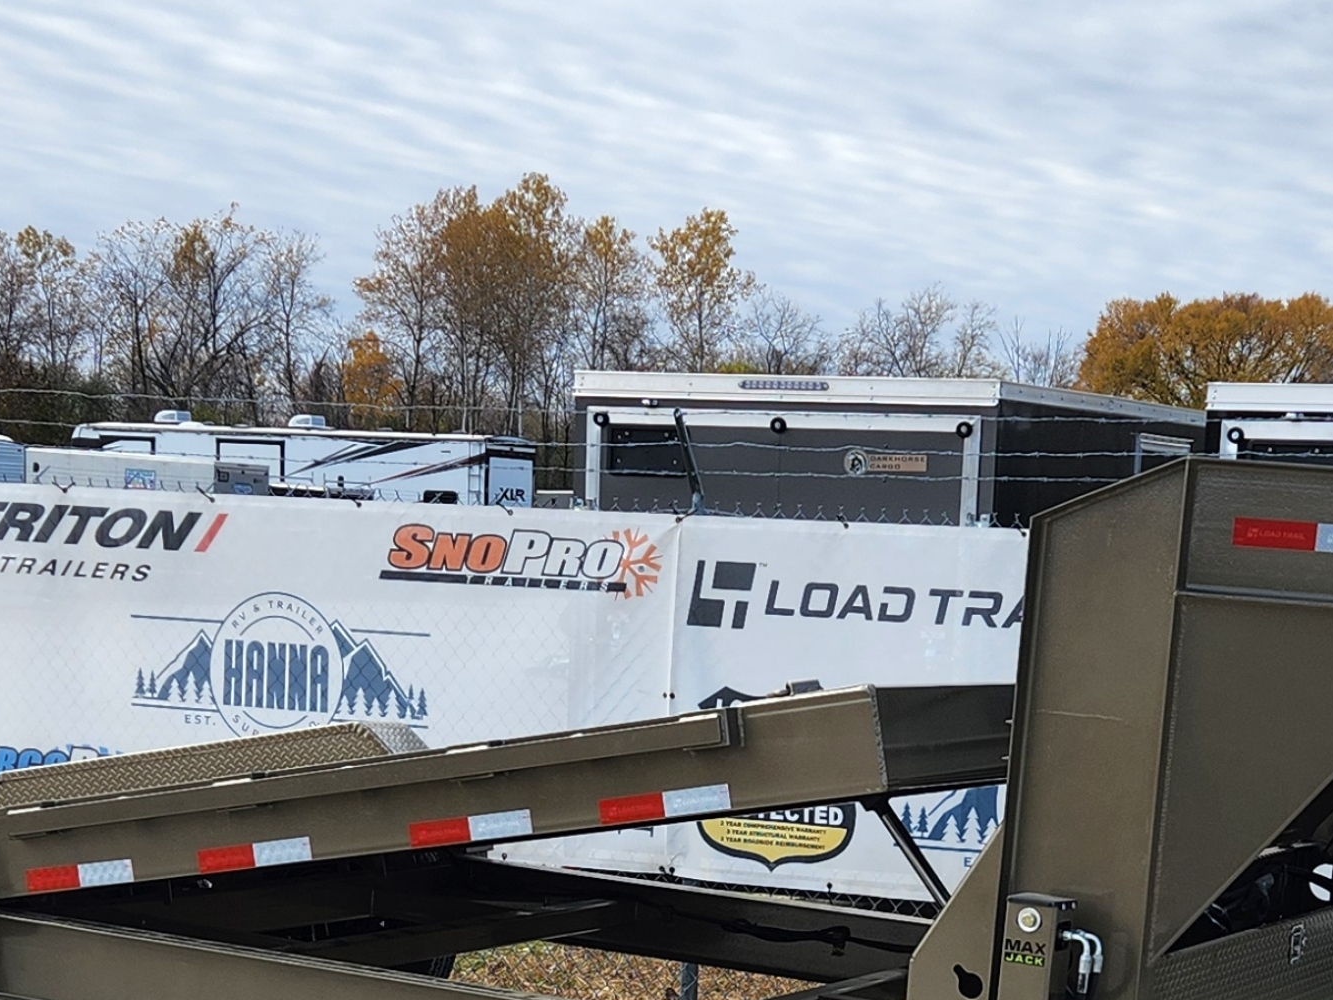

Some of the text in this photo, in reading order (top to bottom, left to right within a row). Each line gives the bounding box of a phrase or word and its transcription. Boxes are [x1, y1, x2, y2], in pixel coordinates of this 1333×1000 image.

[869, 455, 926, 463] DARKHORSE
[498, 487, 526, 502] XLR
[0, 556, 152, 582] TRAILERS
[467, 575, 609, 592] TRAILERS
[764, 580, 917, 623] LOAD
[231, 600, 324, 635] RV & TRAILER
[223, 638, 329, 713] HANNA
[184, 714, 217, 726] EST.
[725, 820, 742, 828] YEAR
[725, 836, 742, 844] YEAR
[749, 830, 788, 840] STRUCTURAL
[1005, 938, 1047, 956] MAX
[1005, 953, 1044, 967] JACK
